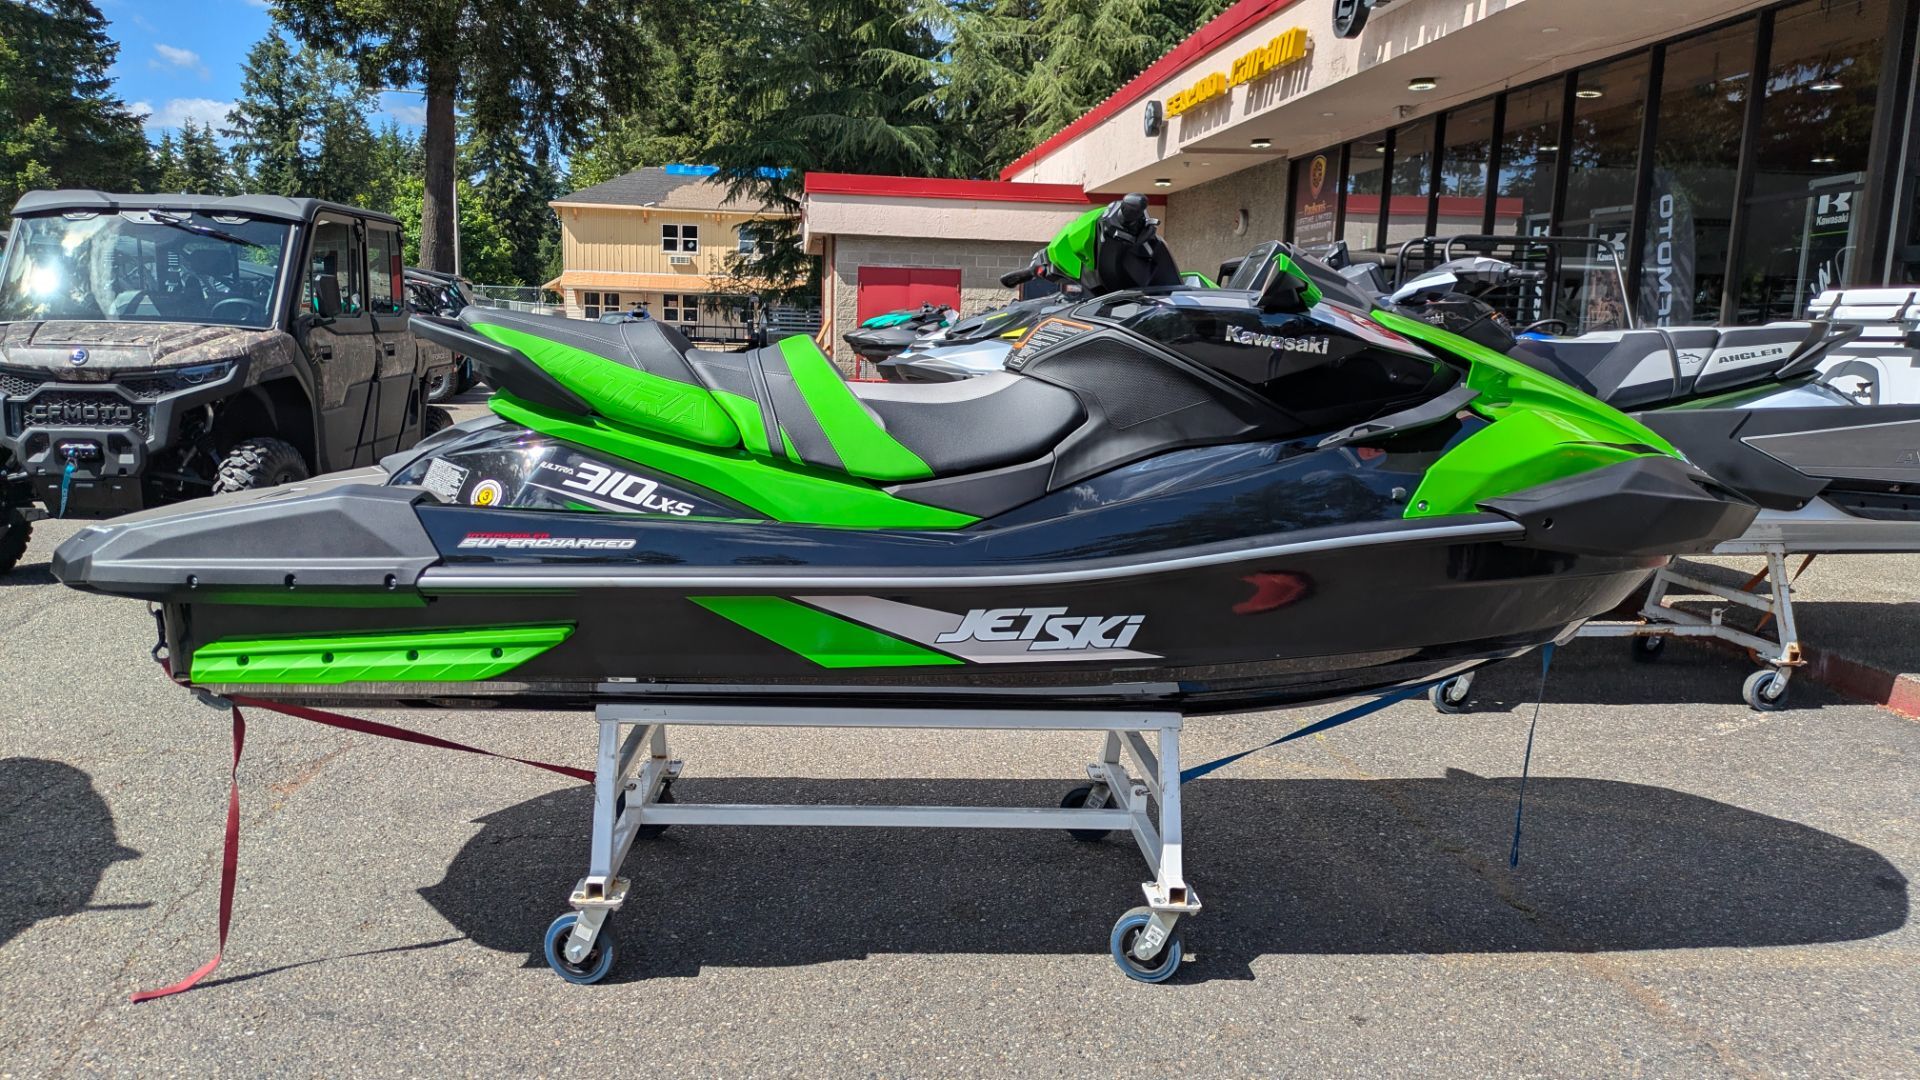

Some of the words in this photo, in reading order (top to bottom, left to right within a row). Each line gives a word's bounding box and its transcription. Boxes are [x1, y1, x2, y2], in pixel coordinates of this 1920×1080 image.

[1816, 213, 1850, 226] Kawasaki
[1225, 325, 1329, 355] Kawasaki
[1719, 347, 1783, 364] ANGLER
[31, 404, 133, 421] CFMOTO
[540, 461, 574, 476] ULTRA
[562, 462, 659, 505] 310
[457, 537, 637, 550] SUPERCHARGED
